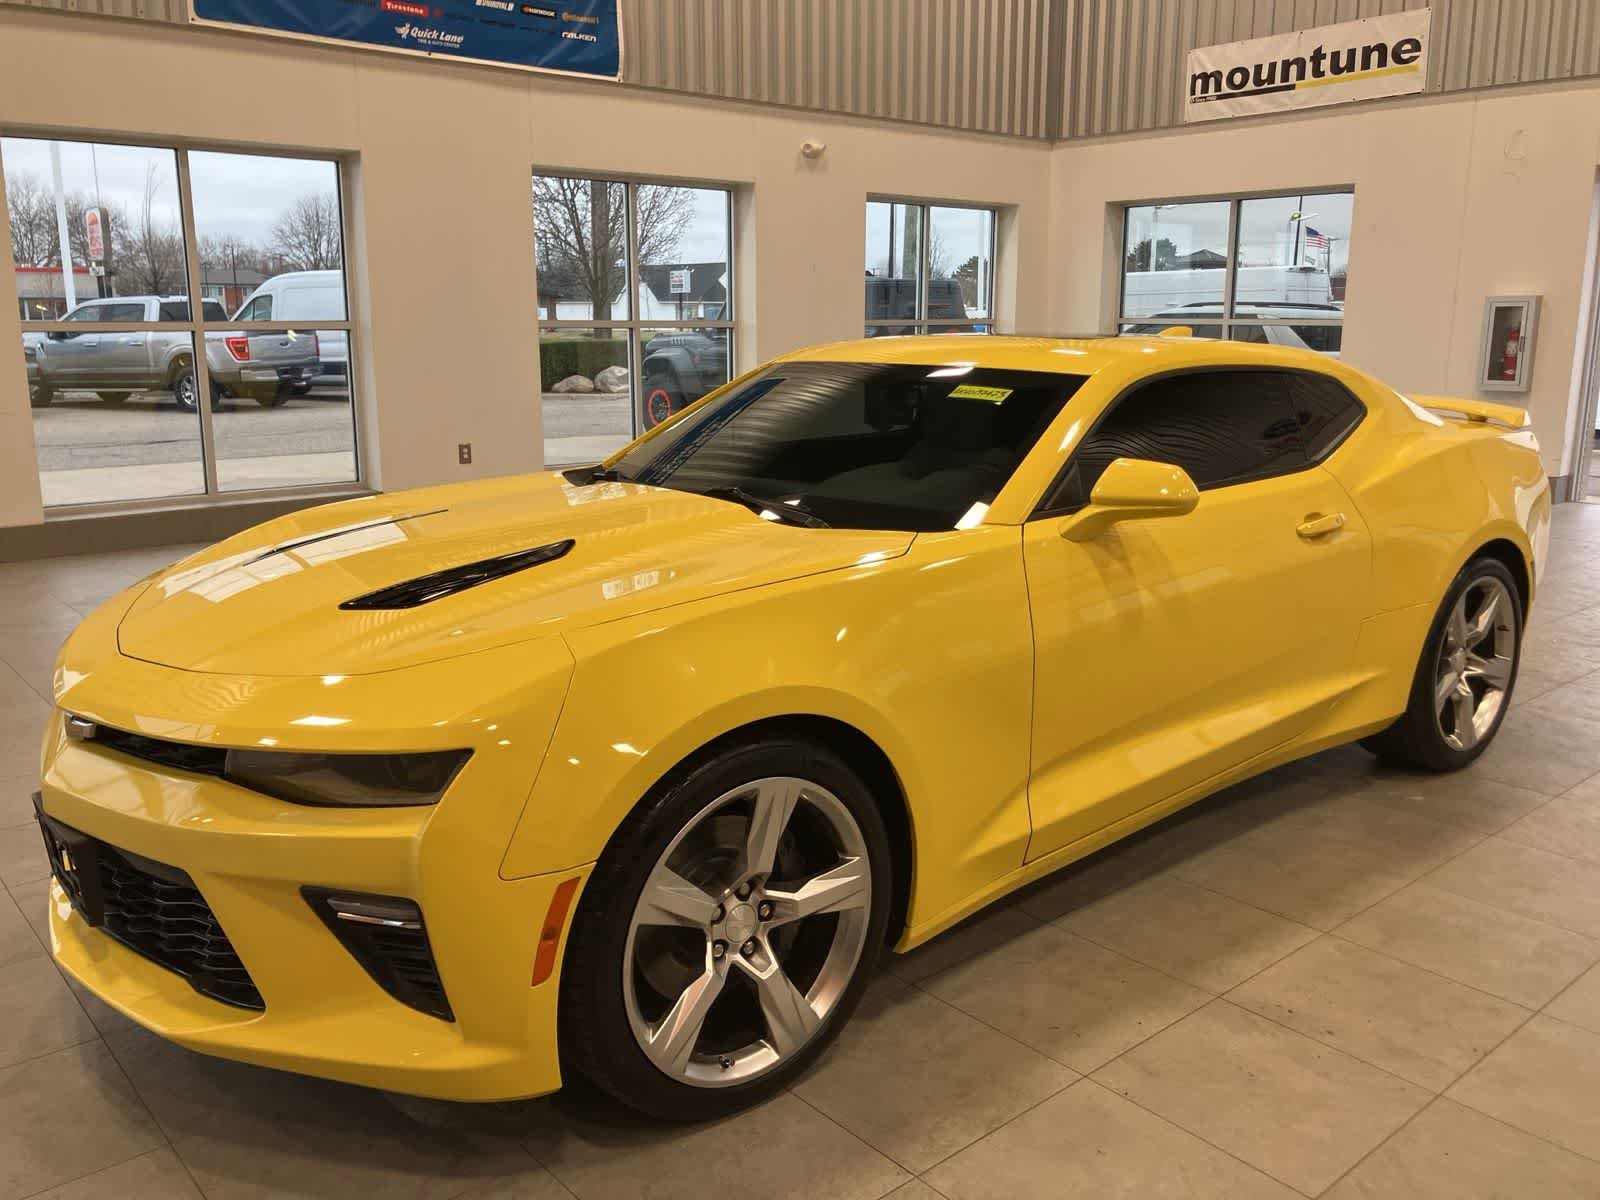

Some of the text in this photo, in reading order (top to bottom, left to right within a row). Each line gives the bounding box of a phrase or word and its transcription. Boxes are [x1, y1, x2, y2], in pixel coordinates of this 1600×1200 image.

[386, 2, 424, 14] Firestone
[410, 26, 464, 43] Quick Lane
[562, 31, 597, 42] FALKEN
[1190, 37, 1422, 96] mountune
